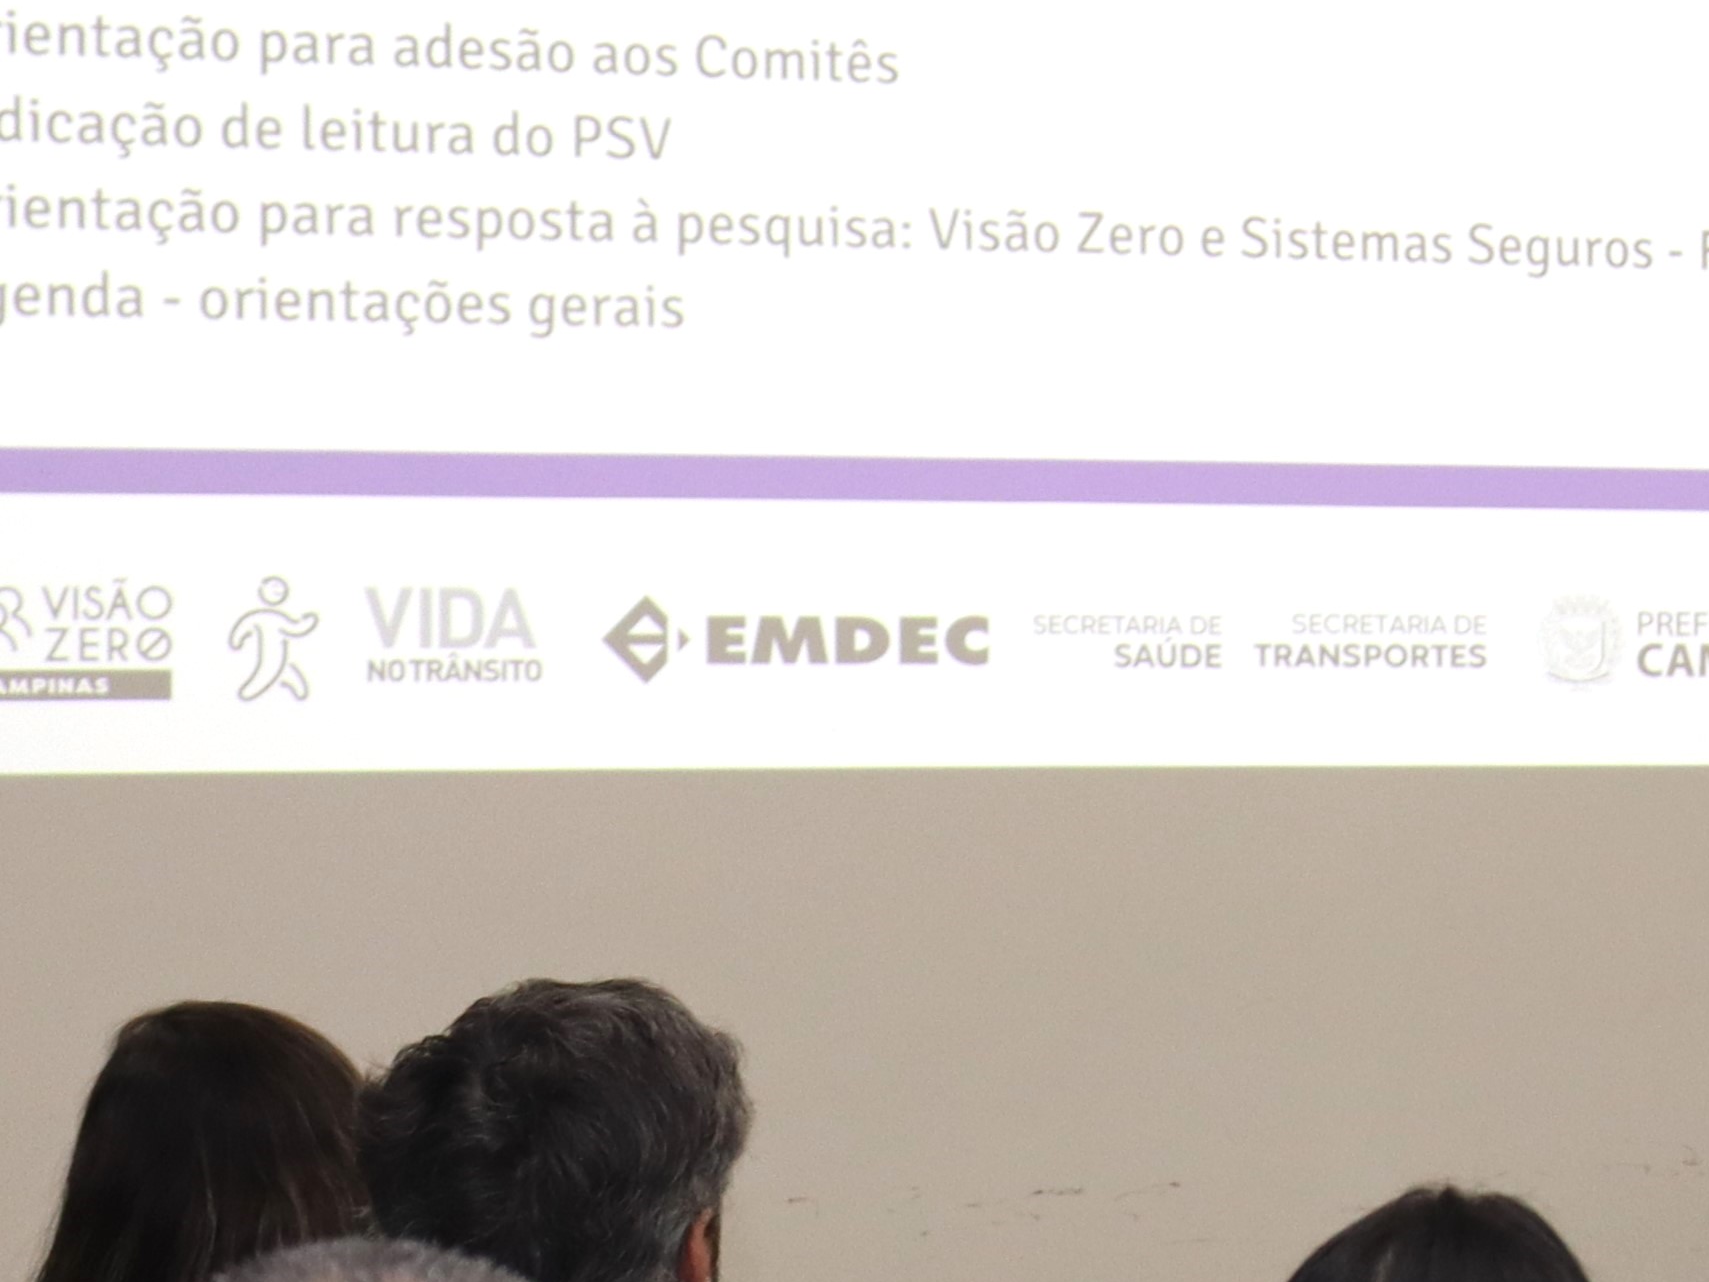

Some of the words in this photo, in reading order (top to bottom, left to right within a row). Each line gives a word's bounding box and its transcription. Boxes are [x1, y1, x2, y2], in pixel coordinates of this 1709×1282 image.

[0, 10, 240, 72] ientação
[260, 30, 374, 75] para
[394, 22, 575, 73] adesão
[593, 42, 679, 77] aos
[696, 34, 899, 84] Comitês
[0, 95, 204, 159] dicação
[222, 102, 283, 150] de
[303, 104, 474, 155] leitura
[493, 110, 554, 157] do
[575, 114, 671, 160] PSV
[0, 183, 240, 245] ientação
[260, 201, 374, 246] para
[395, 200, 614, 251] resposta
[633, 198, 658, 243] à
[678, 205, 911, 258] pesquisa:
[929, 207, 1060, 253] Visão
[1078, 211, 1184, 256] Zero
[1201, 226, 1225, 257] e
[1242, 215, 1452, 264] Sistemas
[1469, 222, 1653, 278] Seguros
[200, 276, 512, 336] orientações
[529, 285, 684, 338] gerais
[41, 576, 175, 622] VISÃO
[364, 584, 538, 650] VIDA
[706, 614, 990, 666] EMDEC
[1033, 614, 1183, 635] SECRETARIA
[1189, 614, 1222, 636] DE
[1292, 612, 1447, 635] SECRETARIA
[1453, 613, 1487, 636] DE
[366, 657, 405, 683] NO
[409, 651, 544, 683] TRÂNSITO
[1114, 635, 1222, 669] SAÚDE
[1255, 642, 1488, 669] TRANSPORTES
